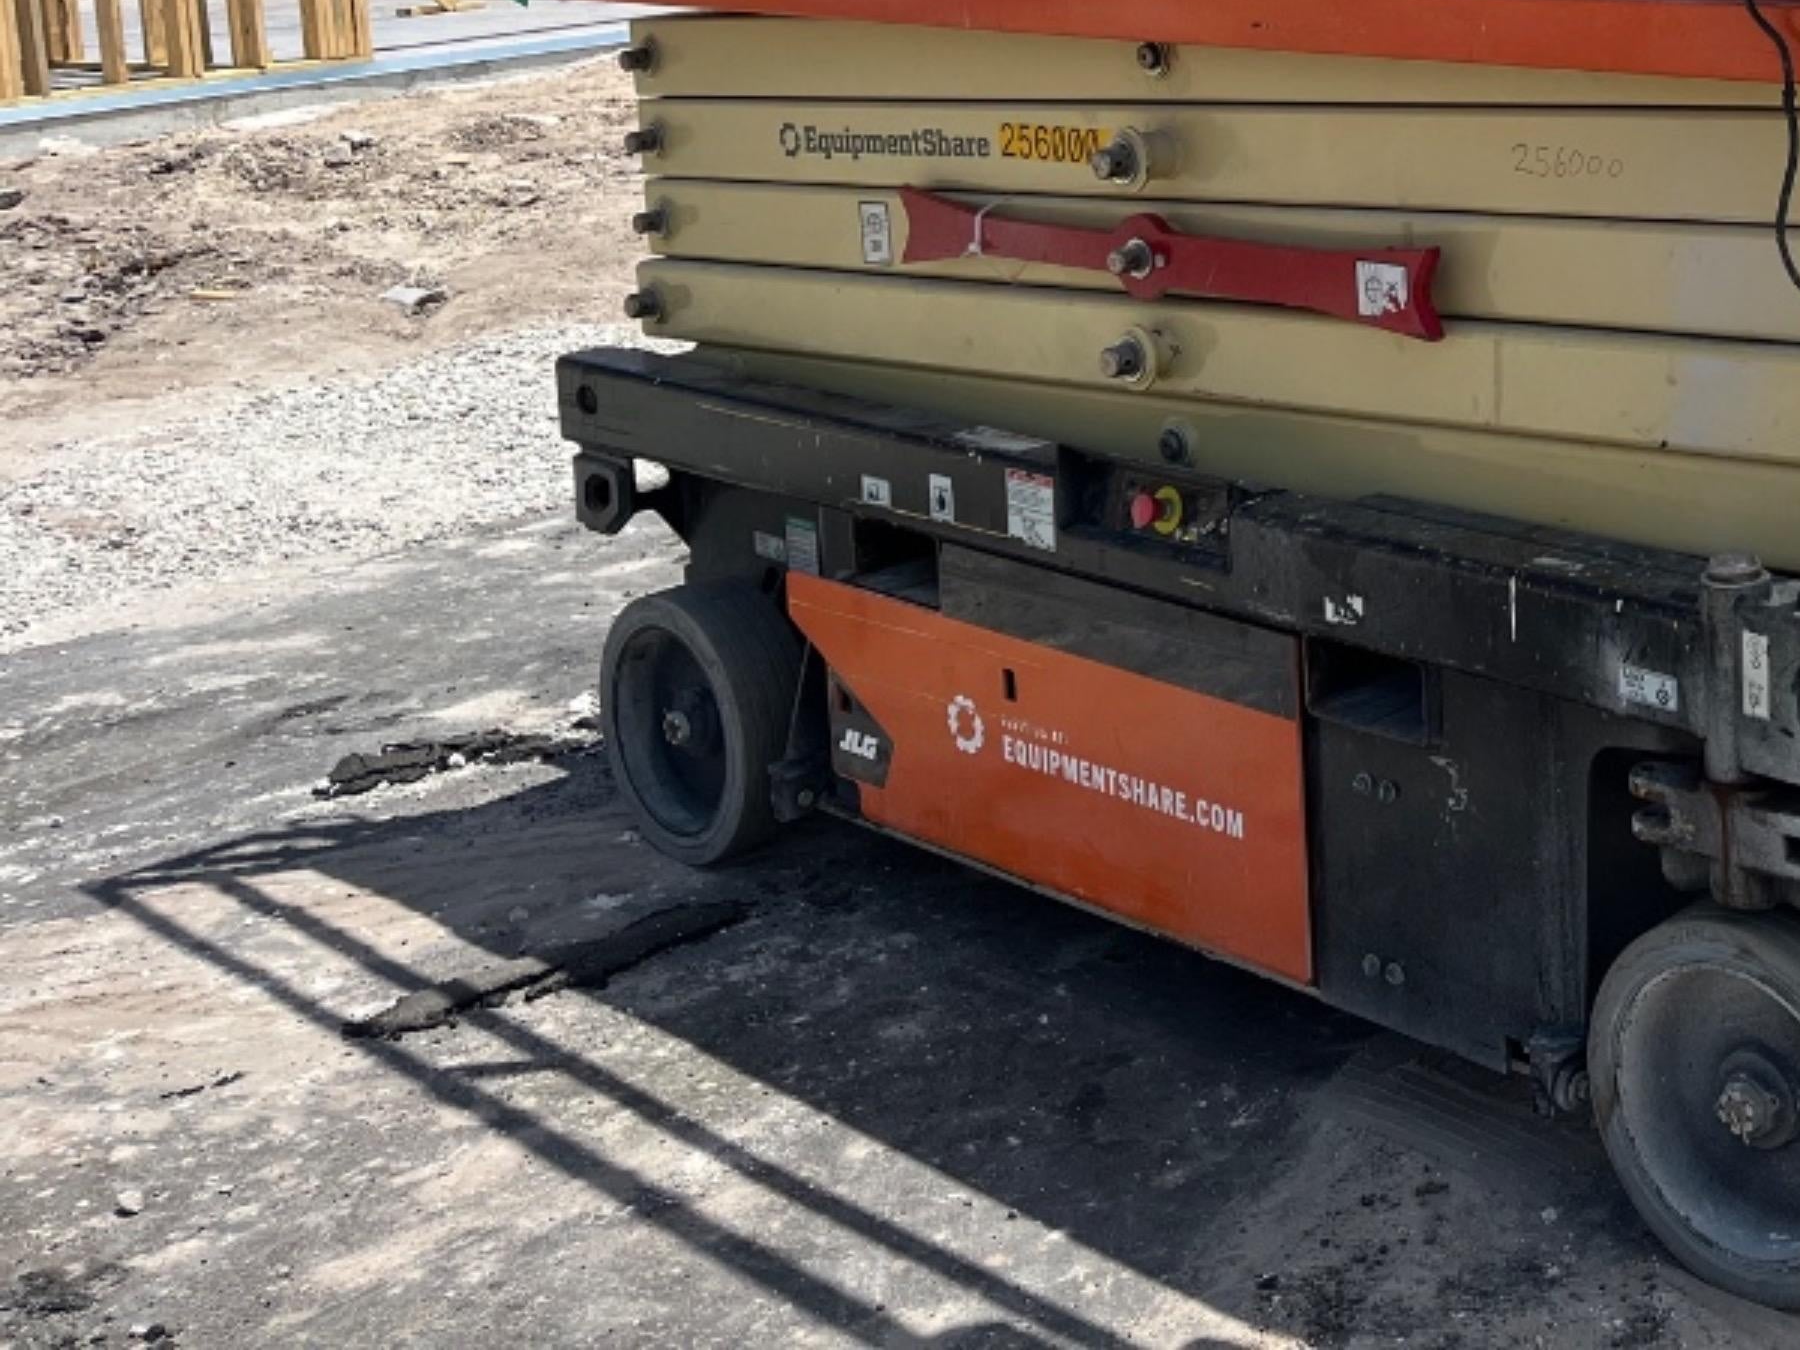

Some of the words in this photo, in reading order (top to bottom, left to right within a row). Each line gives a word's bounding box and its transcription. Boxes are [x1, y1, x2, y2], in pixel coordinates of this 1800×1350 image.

[803, 125, 990, 160] EquipmentShare
[1001, 123, 1099, 163] 256000
[1511, 143, 1624, 178] 256000
[839, 729, 878, 760] JLG
[1003, 733, 1243, 839] EQUIPMENTSHARE.COM
